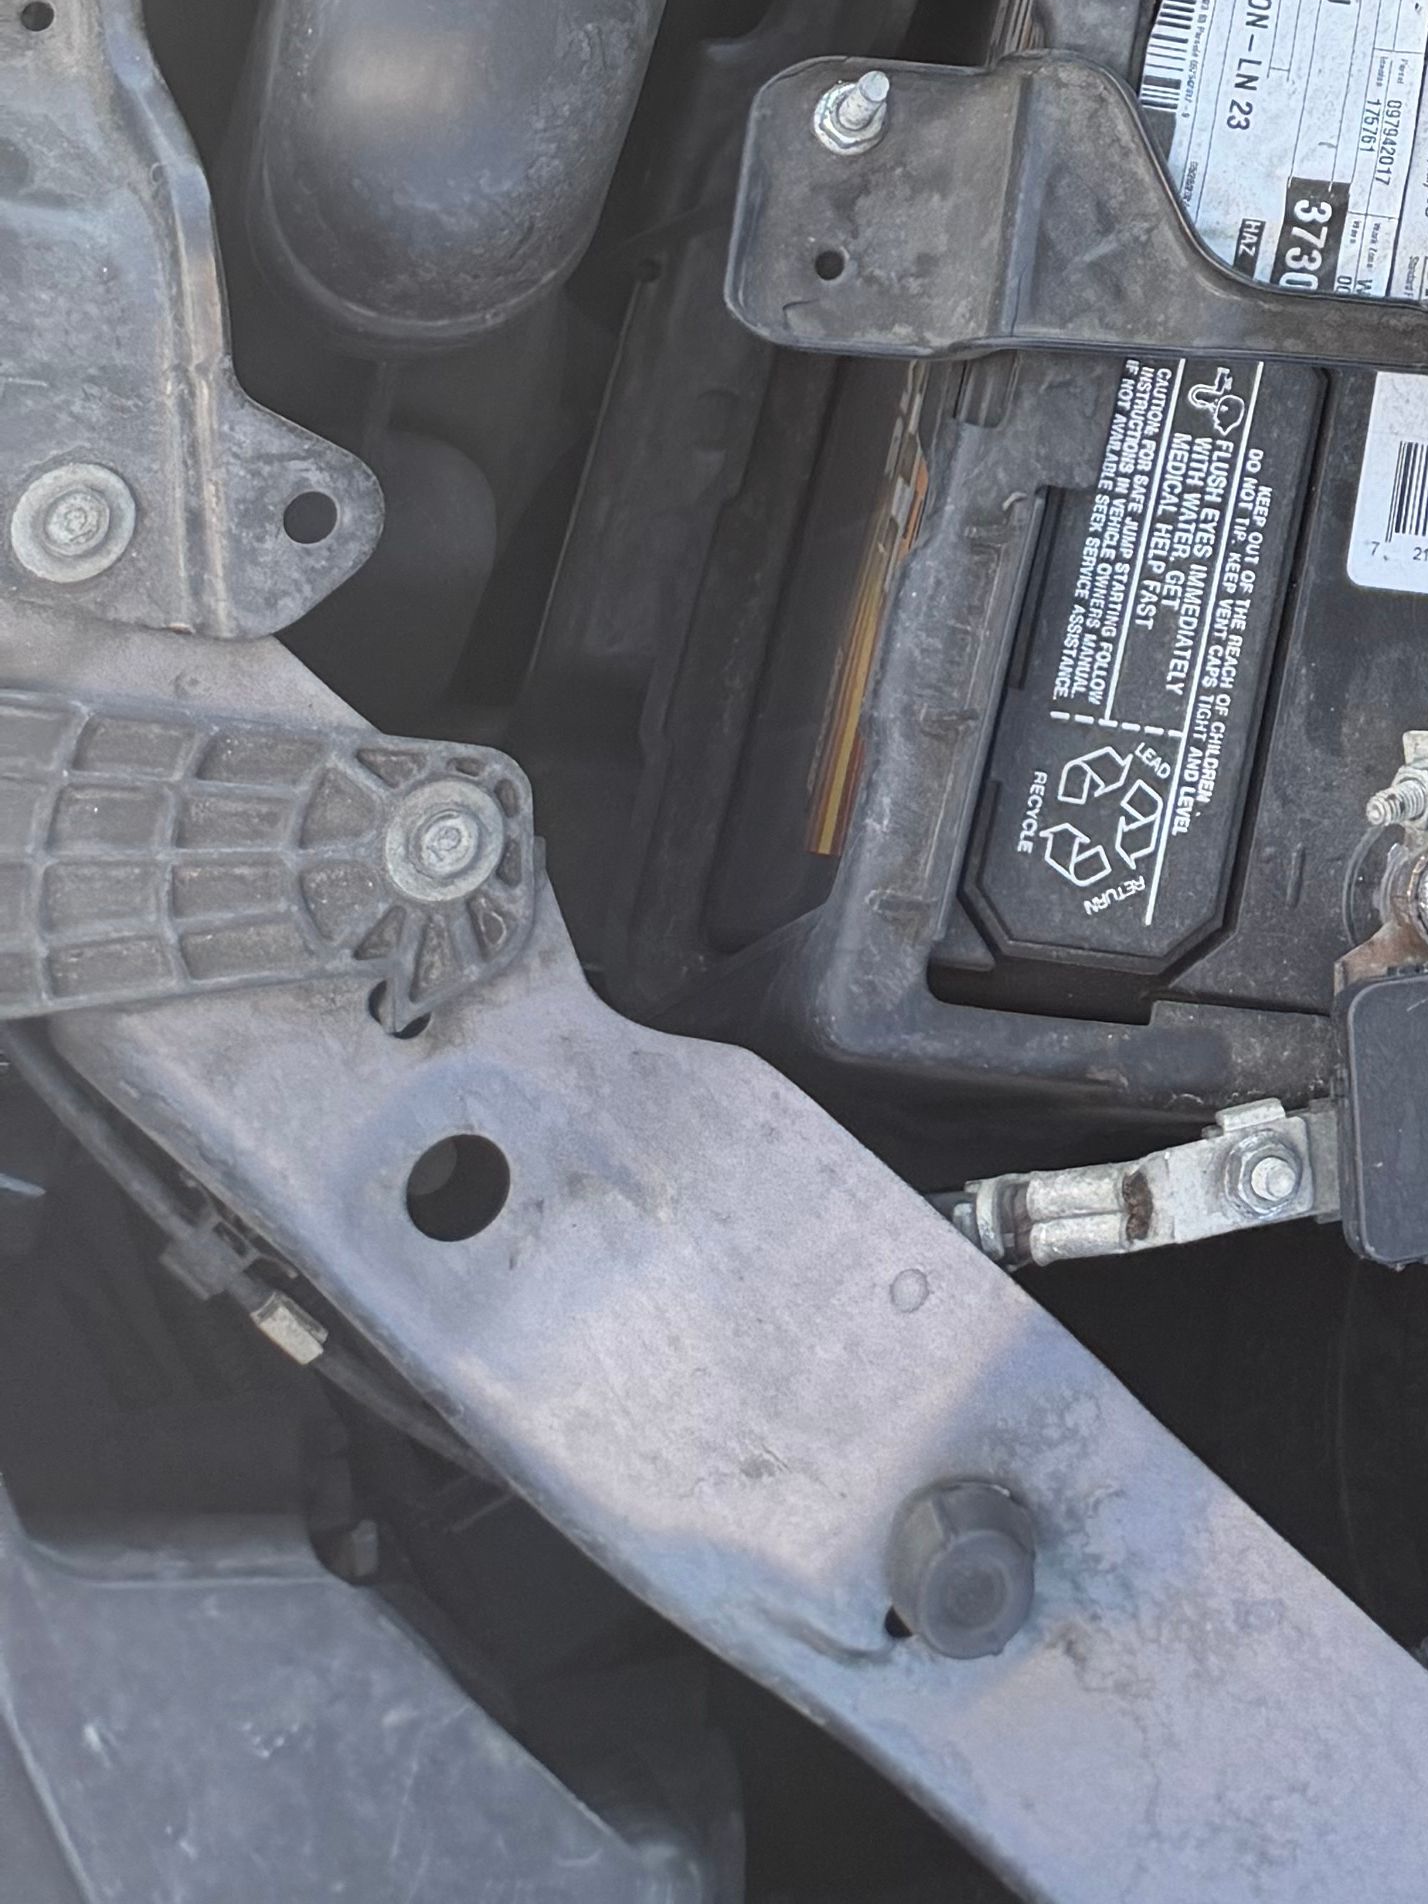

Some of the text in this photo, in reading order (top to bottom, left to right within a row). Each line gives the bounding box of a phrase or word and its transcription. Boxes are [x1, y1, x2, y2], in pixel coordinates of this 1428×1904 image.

[1226, 99, 1253, 130] 23
[1357, 98, 1381, 152] 175761
[1372, 99, 1402, 185] 097942017
[1238, 219, 1261, 256] HAZ
[1136, 438, 1156, 471] FOR
[1127, 474, 1148, 513] SAFE
[1252, 485, 1272, 526] KEEP
[1052, 359, 1139, 699] IF NOT AVAILABLE SEEK SERVICE ASSISTANCE.
[1070, 366, 1154, 698] INSTRUCTIONS IN VEHICLE OWNERS MANUAL.
[1119, 516, 1138, 559] JUMP
[1134, 432, 1192, 629] MEDICAL HELP FAST
[1160, 437, 1212, 610] WITH WATER. GET
[1165, 439, 1233, 694] FLUSH EYES IMMEDIATELY
[1243, 531, 1263, 564] OUT
[1370, 540, 1380, 556] 7
[1100, 562, 1130, 637] STARTING
[1239, 569, 1256, 593] OF
[1229, 598, 1251, 630] THE
[1170, 448, 1263, 835] DO NOT TIP. KEEP VENT CAPS TIGHT AND LEVEL
[1219, 634, 1243, 688] REACH
[1088, 641, 1113, 704] FOLLOW
[1214, 693, 1231, 716] OF
[1134, 741, 1171, 779] LEAD
[1016, 771, 1048, 854] RECYCLE
[1082, 874, 1145, 914] RETURN
